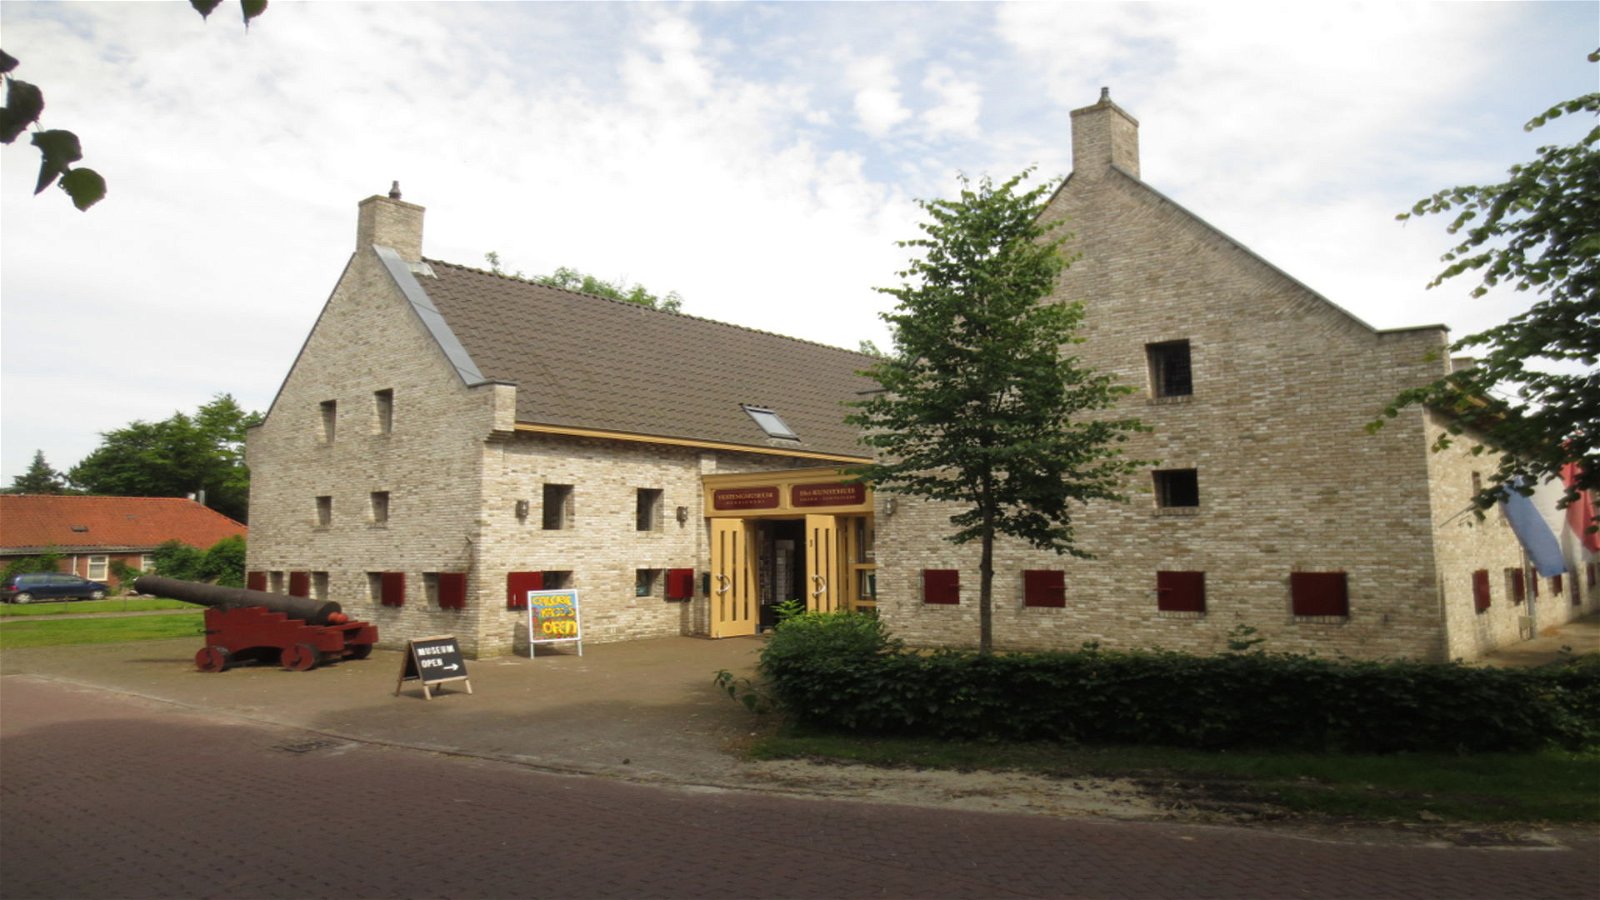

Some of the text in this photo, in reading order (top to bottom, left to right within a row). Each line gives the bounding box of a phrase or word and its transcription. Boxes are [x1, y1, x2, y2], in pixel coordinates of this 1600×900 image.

[543, 620, 577, 634] OPEN
[417, 645, 455, 656] MUSEUM
[421, 658, 443, 668] OPEN
